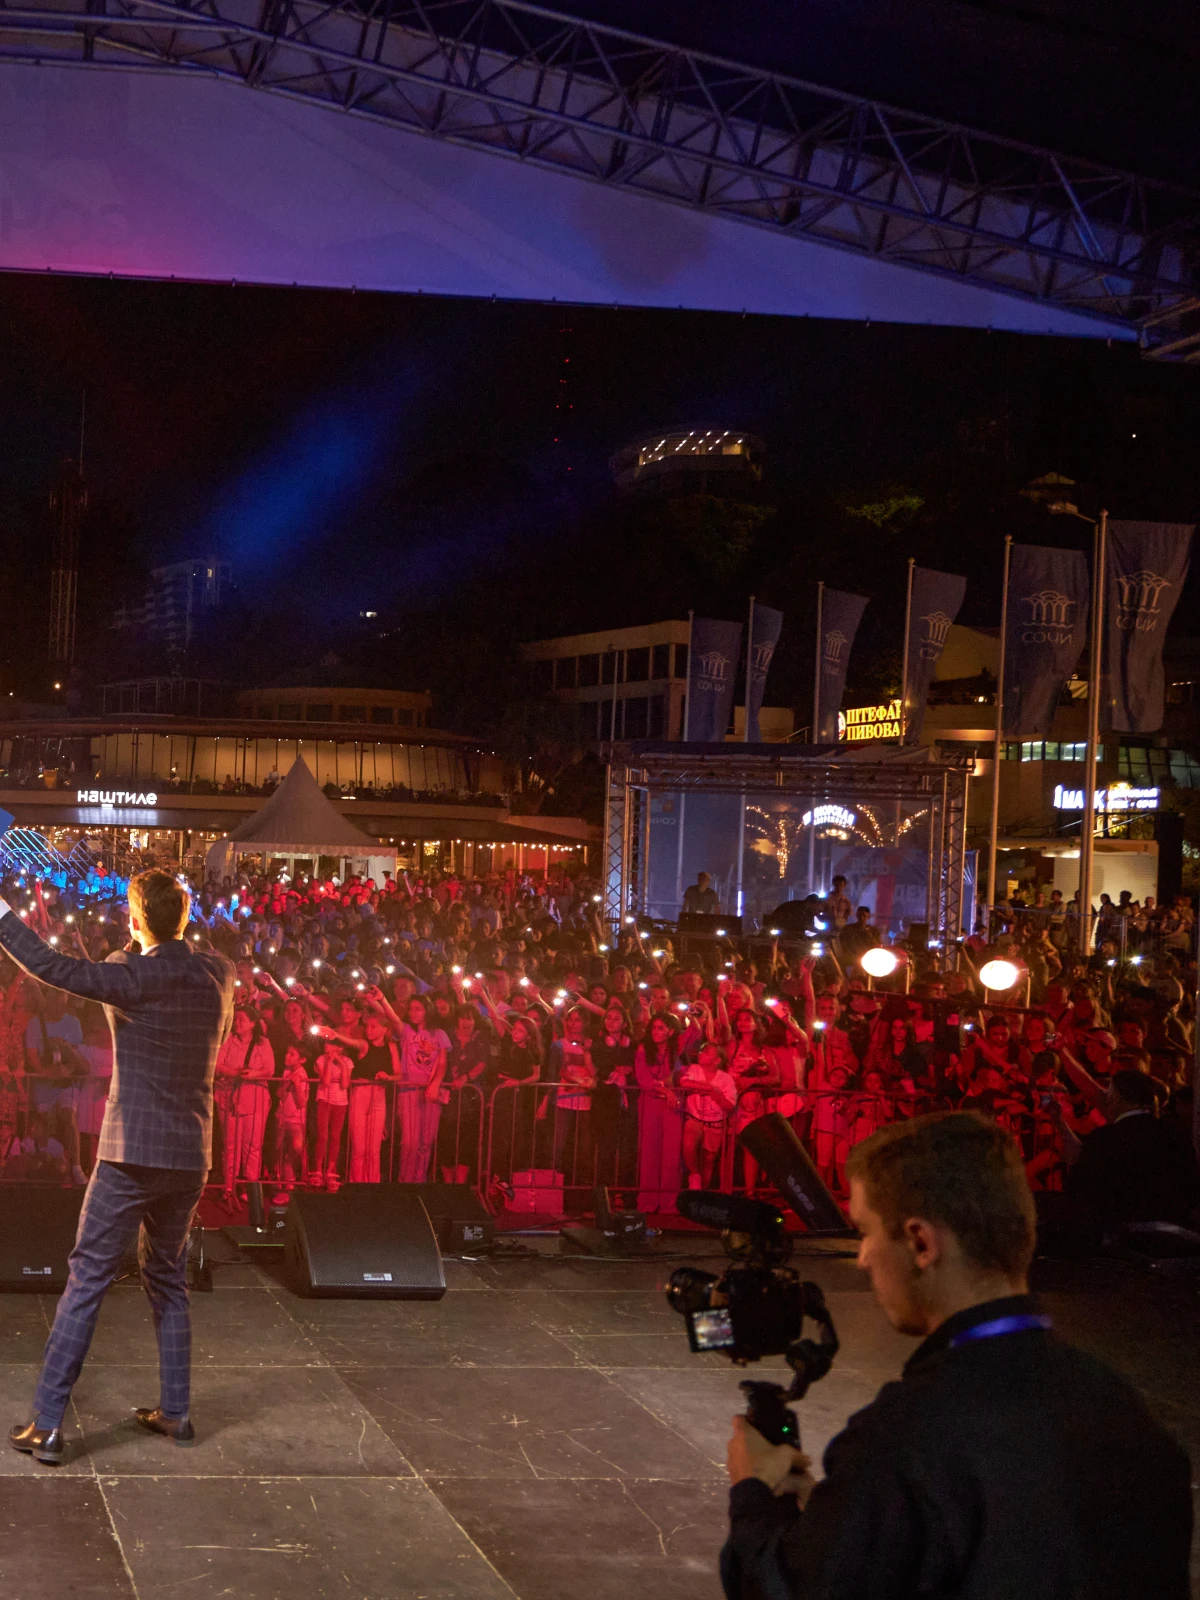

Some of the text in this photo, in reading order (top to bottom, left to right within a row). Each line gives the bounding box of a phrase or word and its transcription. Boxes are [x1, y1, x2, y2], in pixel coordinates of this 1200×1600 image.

[1022, 631, 1073, 645] СОЧИ
[846, 721, 901, 741] ПИВОВА
[1061, 789, 1106, 809] МАК
